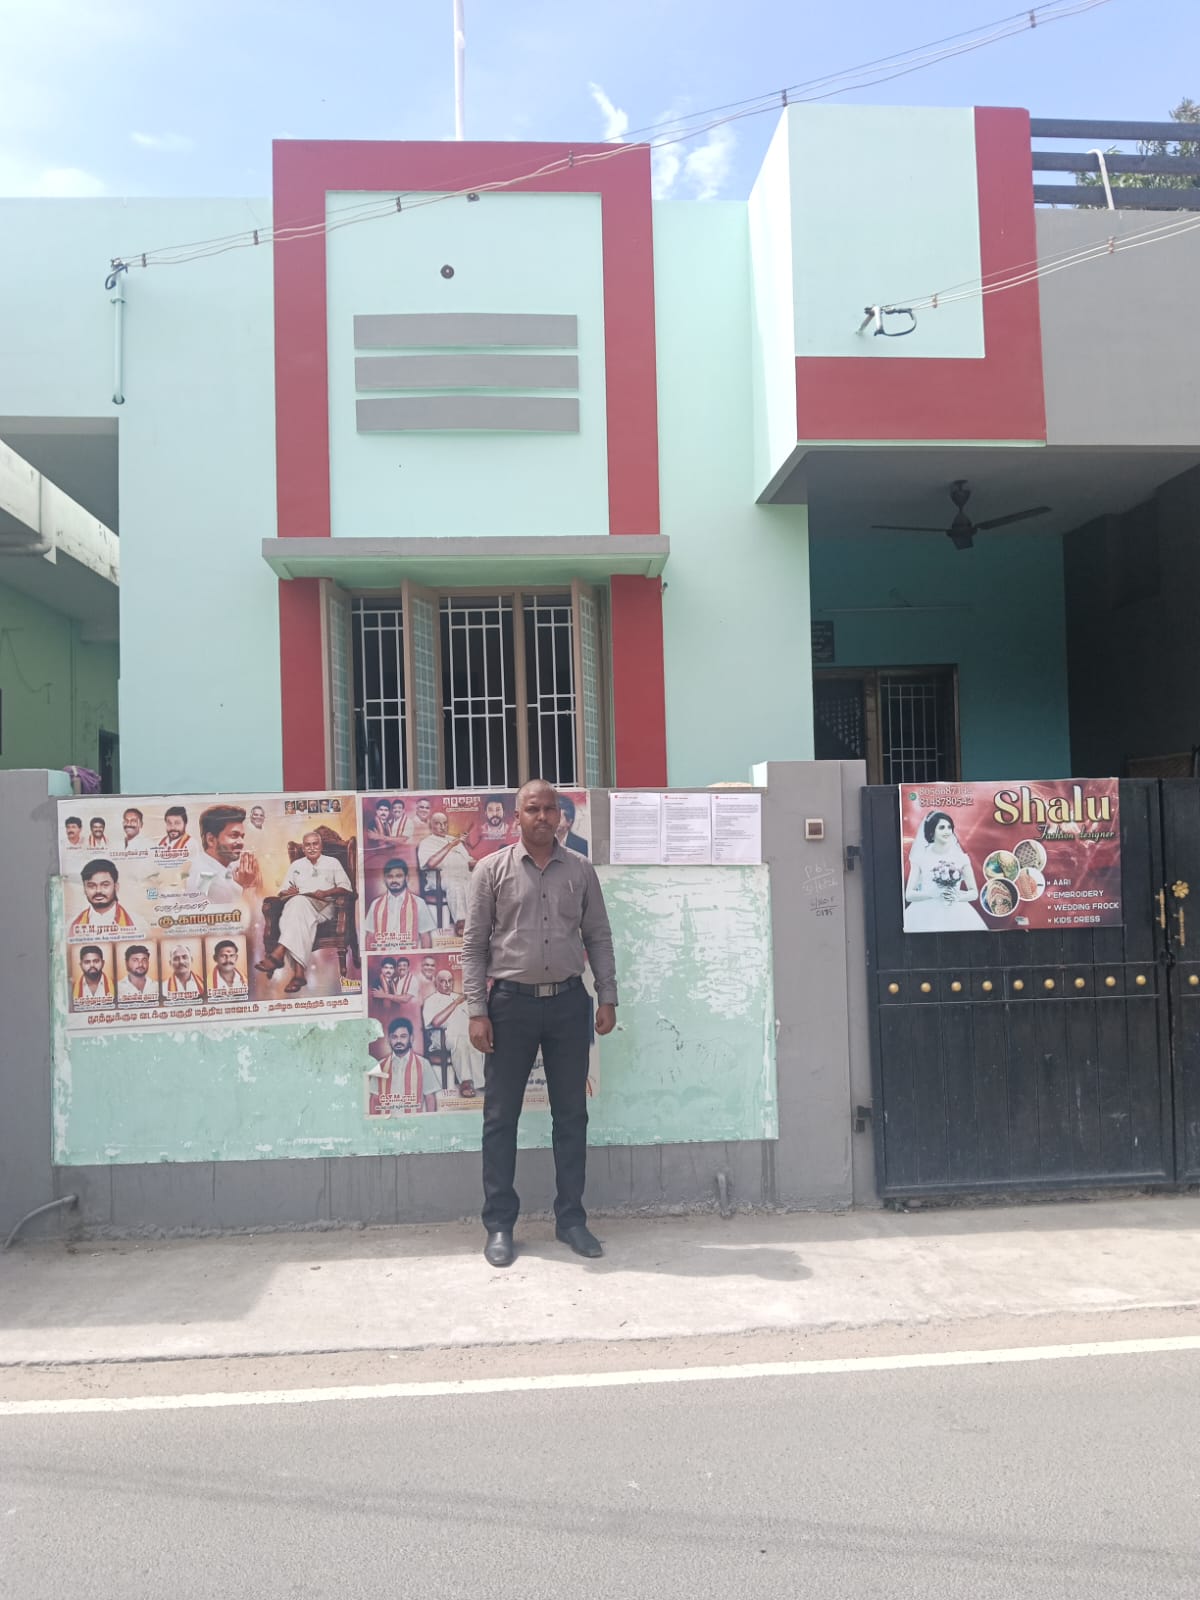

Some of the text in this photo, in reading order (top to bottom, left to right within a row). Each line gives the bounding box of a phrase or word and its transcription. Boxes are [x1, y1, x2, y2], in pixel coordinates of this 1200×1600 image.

[919, 796, 974, 808] 8148780542
[993, 785, 1112, 825] Shalu
[1036, 823, 1116, 843] Fashion designer
[1052, 878, 1072, 887] AARI
[1053, 889, 1105, 899] EMBROIDERY
[1053, 901, 1120, 912] WEDDING FROCK
[1053, 915, 1101, 925] KIDS DRESS
